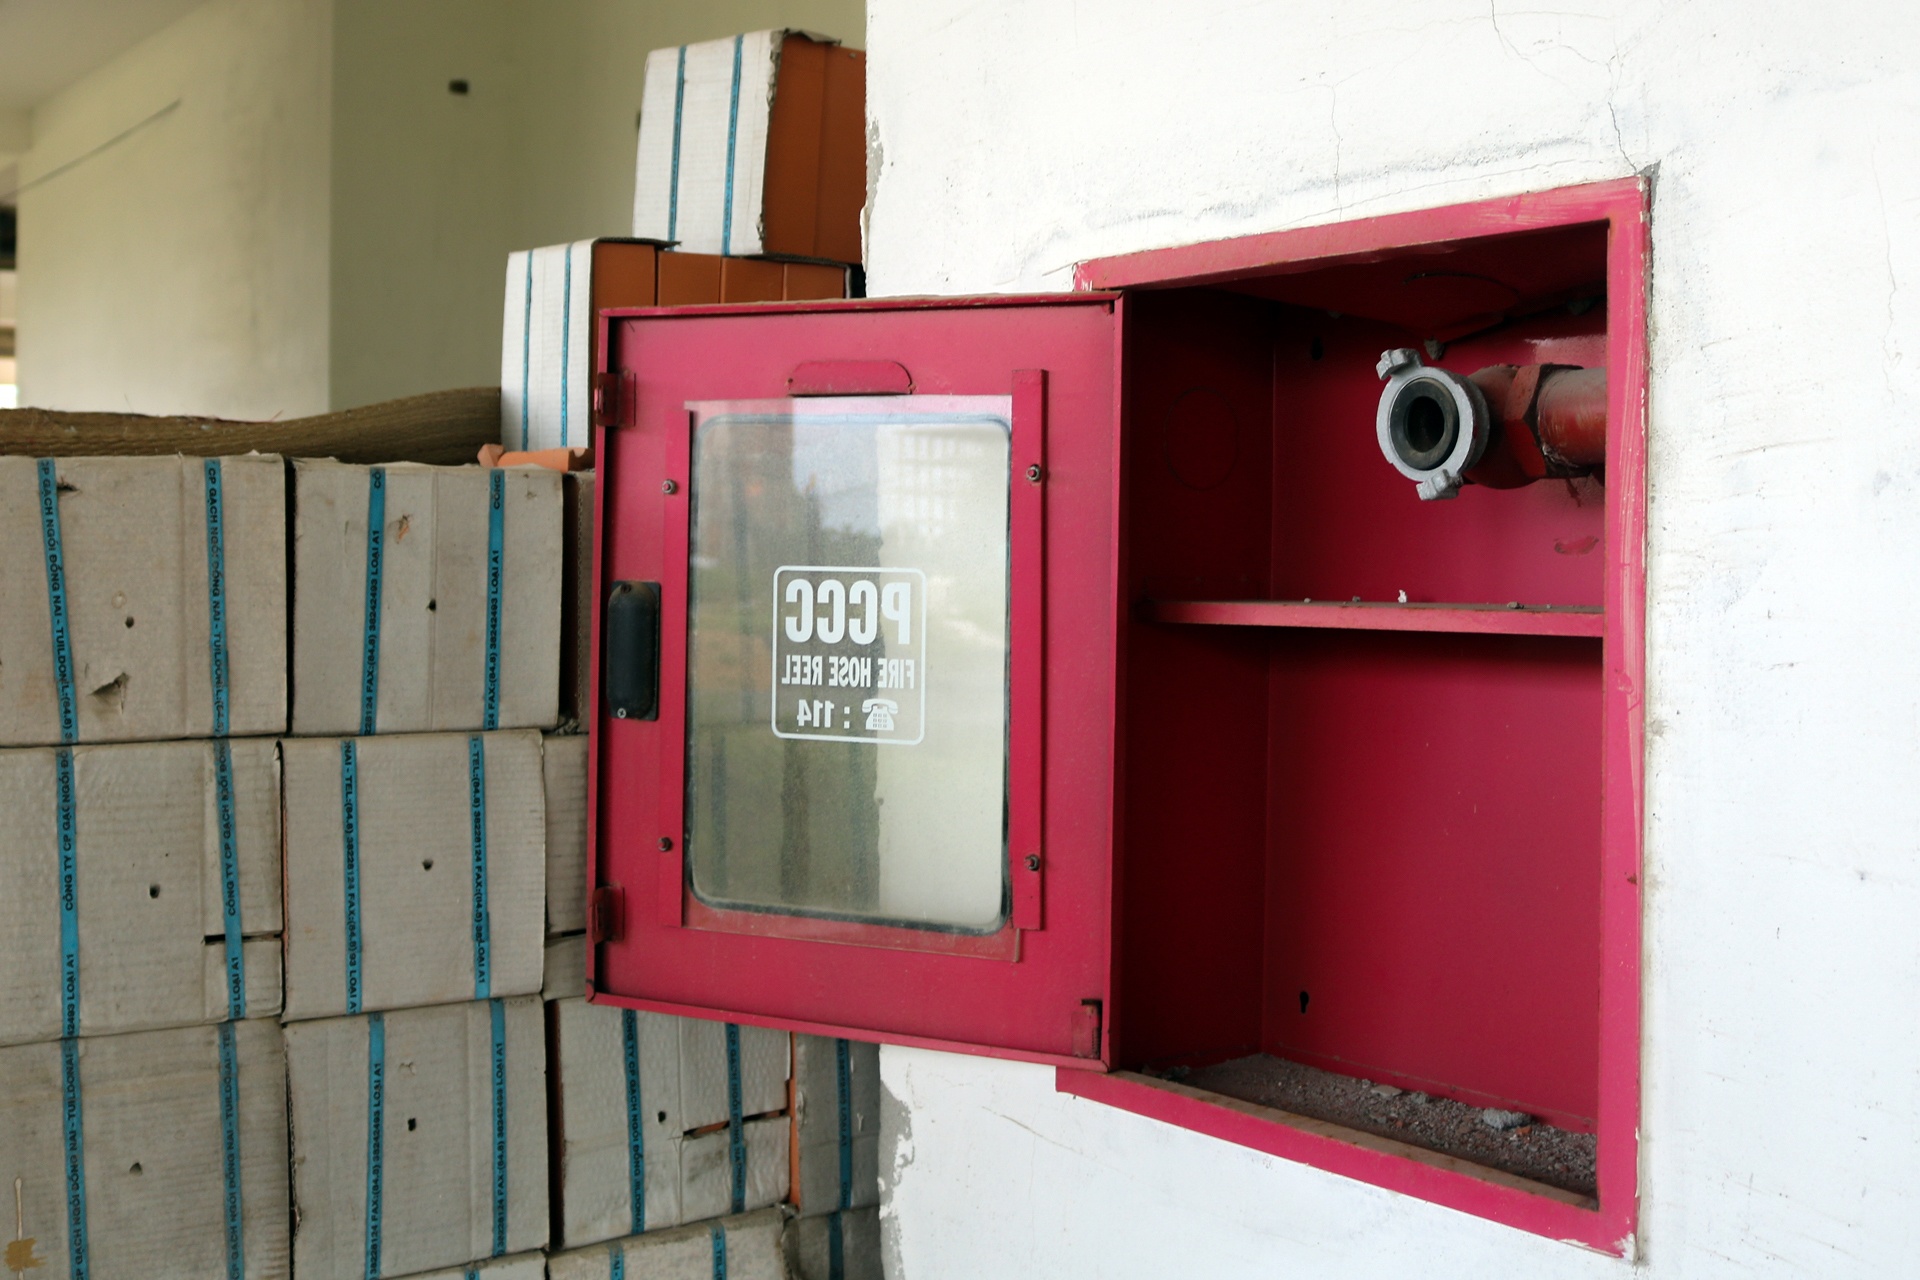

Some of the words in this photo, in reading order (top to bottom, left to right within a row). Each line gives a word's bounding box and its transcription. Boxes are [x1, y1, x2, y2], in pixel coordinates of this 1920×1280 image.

[208, 467, 216, 483] CP
[372, 530, 379, 543] A1
[52, 595, 62, 615] NAI
[487, 652, 497, 709] FAX:(84.8)
[492, 550, 499, 563] A1
[343, 775, 354, 833] TEL:(84.8)
[63, 834, 71, 851] CP
[223, 843, 232, 859] CP
[63, 855, 71, 870] TY
[225, 863, 233, 878] TY
[471, 751, 481, 807] TEL:(84.8)
[478, 970, 485, 982] A1
[62, 874, 73, 910] CÔNG
[224, 881, 235, 915] CÔNG
[65, 954, 74, 967] A1
[231, 957, 238, 969] A1
[347, 970, 356, 998] LOẠI
[496, 1043, 502, 1055] A1
[627, 1044, 634, 1057] TY
[373, 1063, 381, 1075] A1
[628, 1061, 635, 1075] CP
[68, 1130, 77, 1150] NAI
[226, 1130, 234, 1150] NAI
